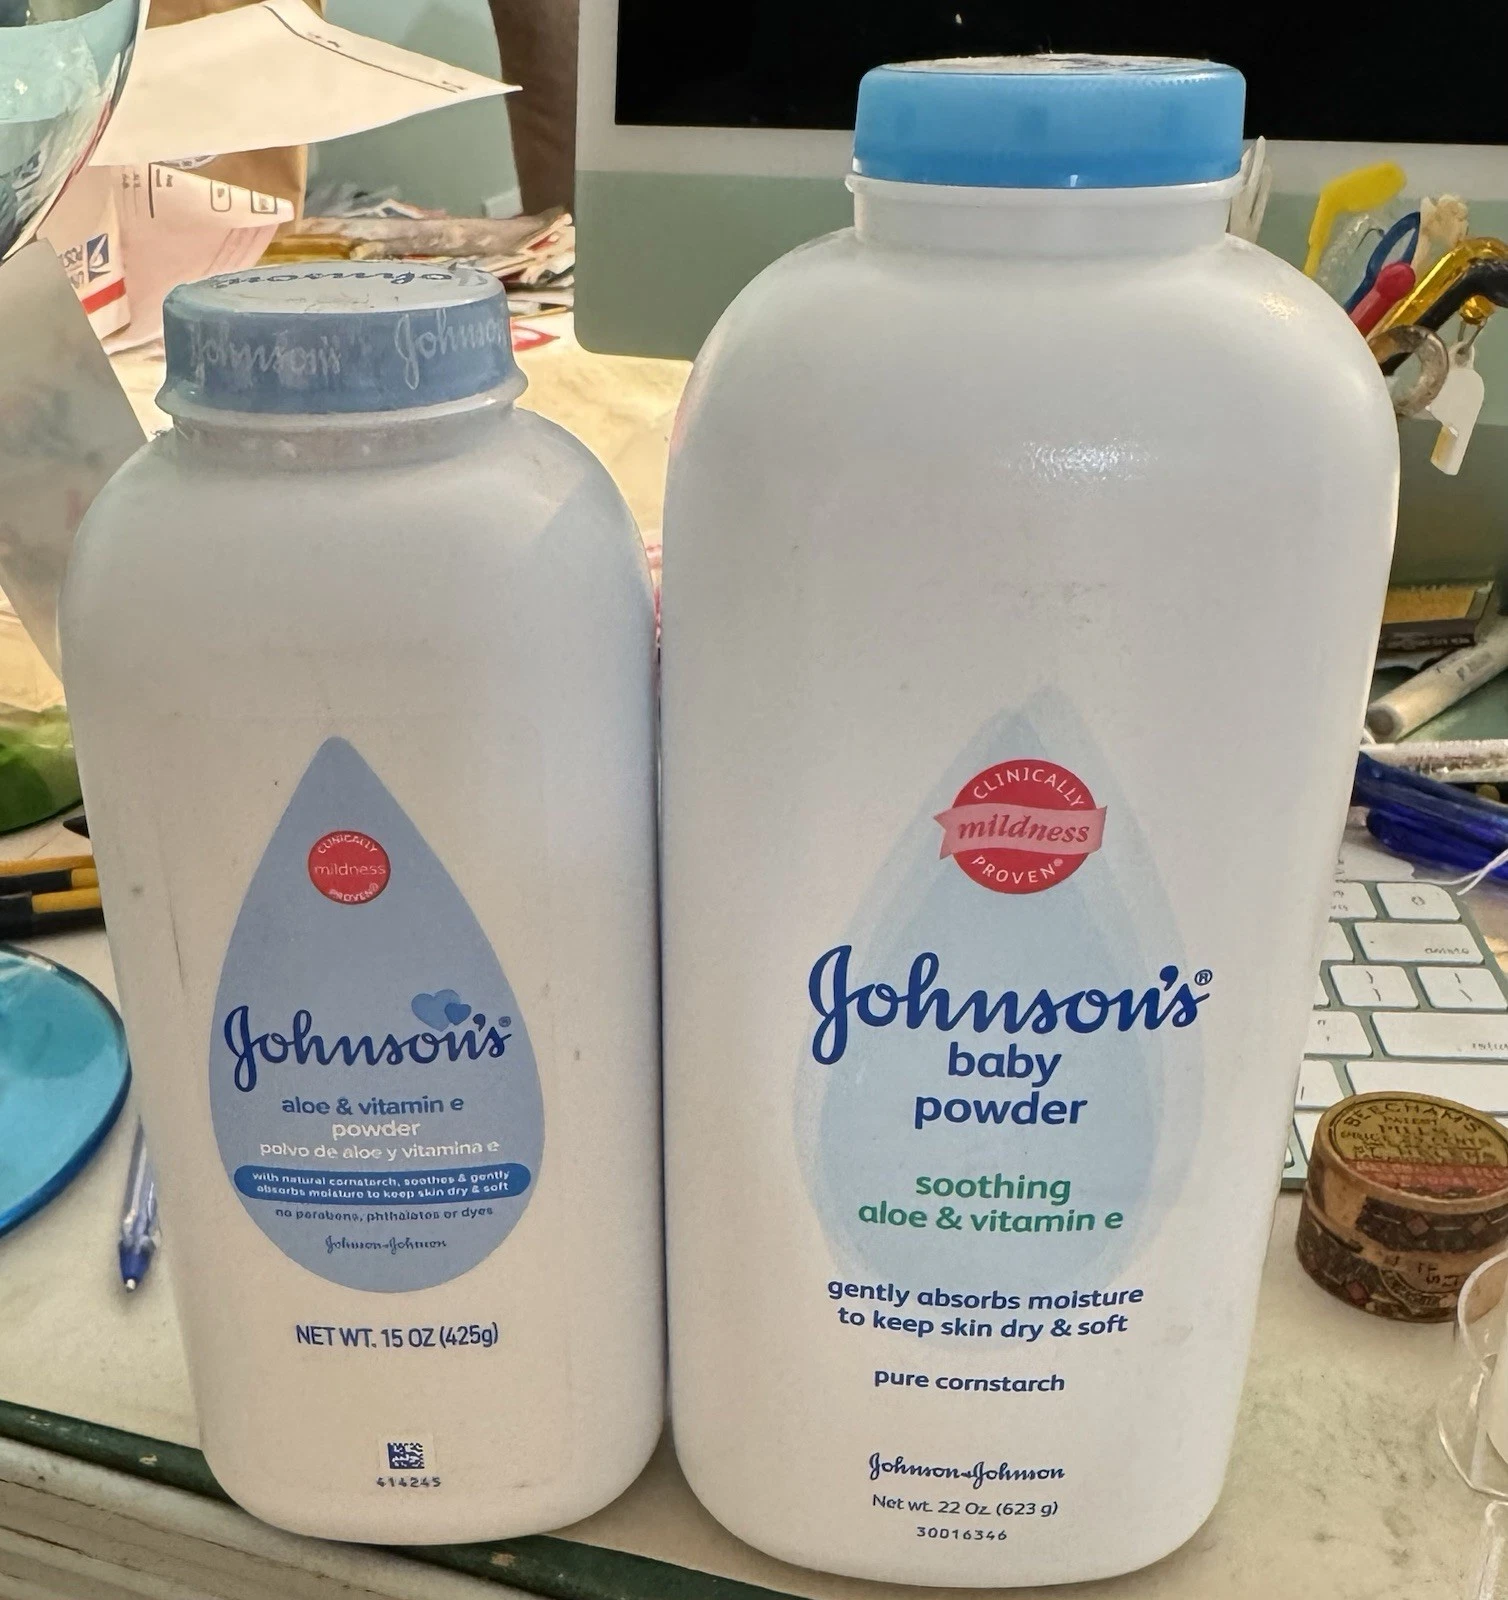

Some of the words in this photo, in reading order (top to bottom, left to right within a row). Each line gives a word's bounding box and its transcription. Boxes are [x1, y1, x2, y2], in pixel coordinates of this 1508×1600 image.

[973, 767, 1085, 807] CLINICALLY
[959, 813, 1091, 843] mildness
[313, 863, 386, 876] mildness
[948, 1042, 1062, 1088] baby
[281, 1096, 331, 1115] aloe
[336, 1097, 353, 1115] &
[358, 1095, 444, 1116] vitamin
[450, 1097, 464, 1111] e
[914, 1092, 1088, 1130] powder
[332, 1120, 421, 1141] powder
[260, 1143, 310, 1158] polvo
[314, 1146, 339, 1159] de
[343, 1146, 382, 1160] aloe
[386, 1149, 398, 1162] y
[402, 1141, 483, 1158] vitamina
[487, 1141, 500, 1153] e
[252, 1173, 280, 1183] with
[282, 1176, 327, 1186] natural
[458, 1174, 467, 1183] &
[367, 1190, 381, 1199] to
[447, 1187, 469, 1197] dry
[471, 1185, 481, 1194] &
[483, 1181, 510, 1192] soft
[915, 1173, 1071, 1206] soothing
[276, 1209, 293, 1218] no
[444, 1210, 459, 1219] or
[858, 1201, 928, 1228] aloe
[935, 1206, 963, 1231] &
[970, 1209, 1096, 1233] vitamin
[1104, 1211, 1124, 1229] e
[827, 1280, 910, 1308] gently
[916, 1288, 1021, 1310] absorbs
[1027, 1288, 1145, 1310] moisture
[296, 1324, 335, 1346] NET
[339, 1327, 377, 1348] WT.
[381, 1329, 403, 1347] 15
[408, 1328, 436, 1347] OZ
[439, 1322, 499, 1348] (425g)
[837, 1307, 865, 1327] to
[872, 1310, 935, 1338] keep
[940, 1318, 993, 1338] skin
[1000, 1319, 1044, 1343] dry
[1049, 1318, 1072, 1338] &
[1077, 1313, 1129, 1337] soft
[874, 1369, 930, 1389] pure
[935, 1374, 1066, 1393] cornstarch
[872, 1494, 904, 1509] Net
[937, 1501, 961, 1515] 22
[965, 1502, 991, 1515] Oz
[995, 1503, 1037, 1517] (623
[1040, 1501, 1059, 1518] g)
[916, 1526, 1008, 1541] 30016346
